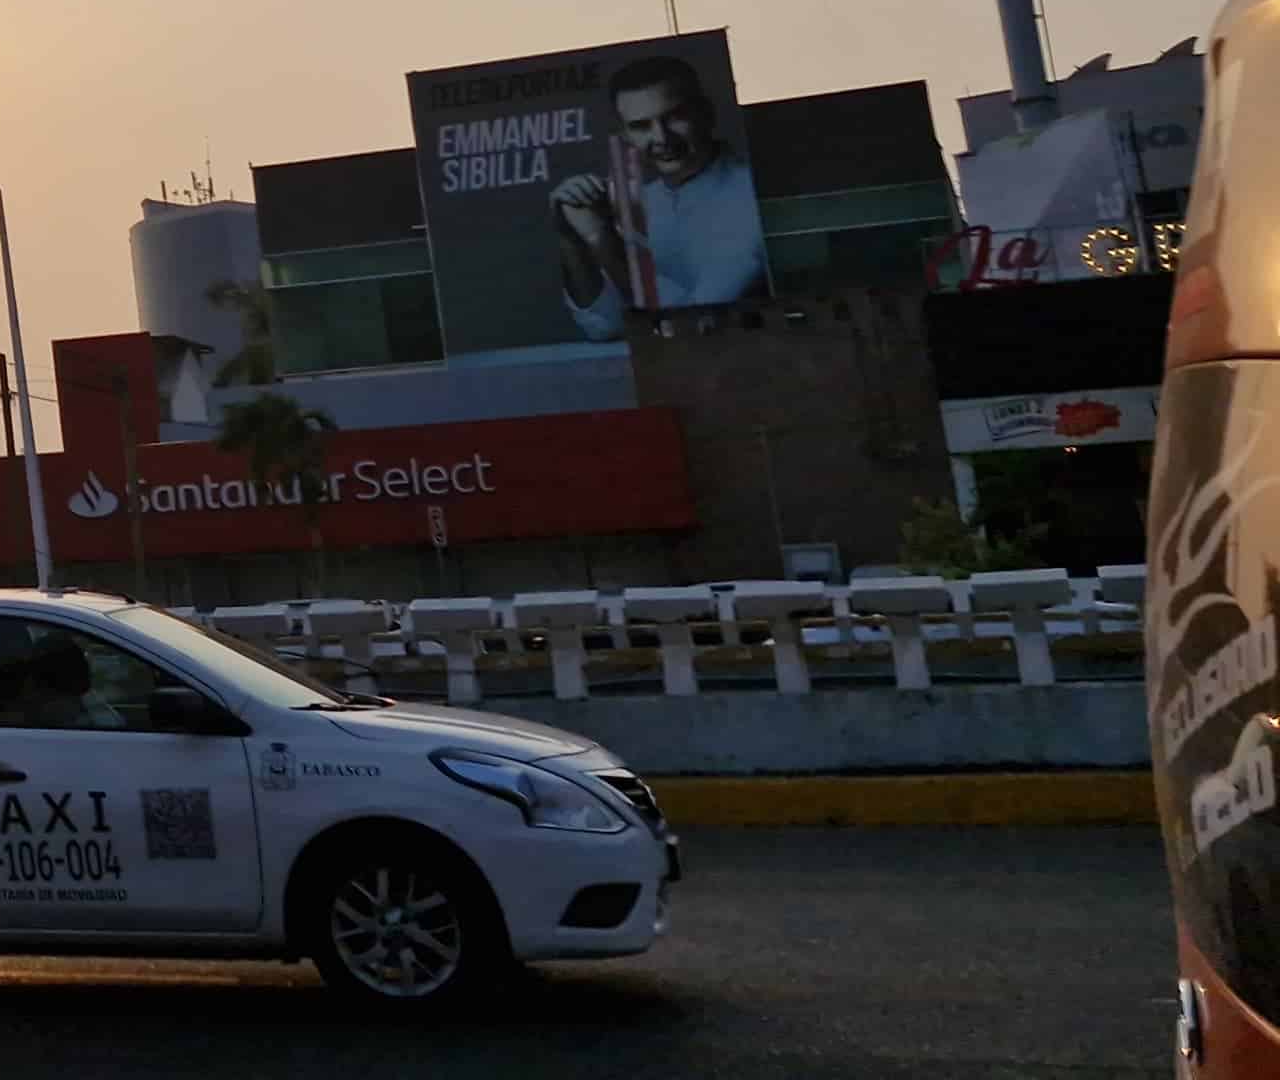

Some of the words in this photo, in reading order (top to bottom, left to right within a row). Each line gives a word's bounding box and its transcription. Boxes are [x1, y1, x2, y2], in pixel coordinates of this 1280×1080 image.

[439, 107, 592, 159] EMMANUEL
[441, 149, 550, 192] SIBILLA
[926, 224, 1050, 295] La
[352, 453, 497, 501] Select
[302, 762, 381, 777] TABASCO
[38, 888, 53, 901] DE
[56, 887, 128, 902] MOVILIDAD
